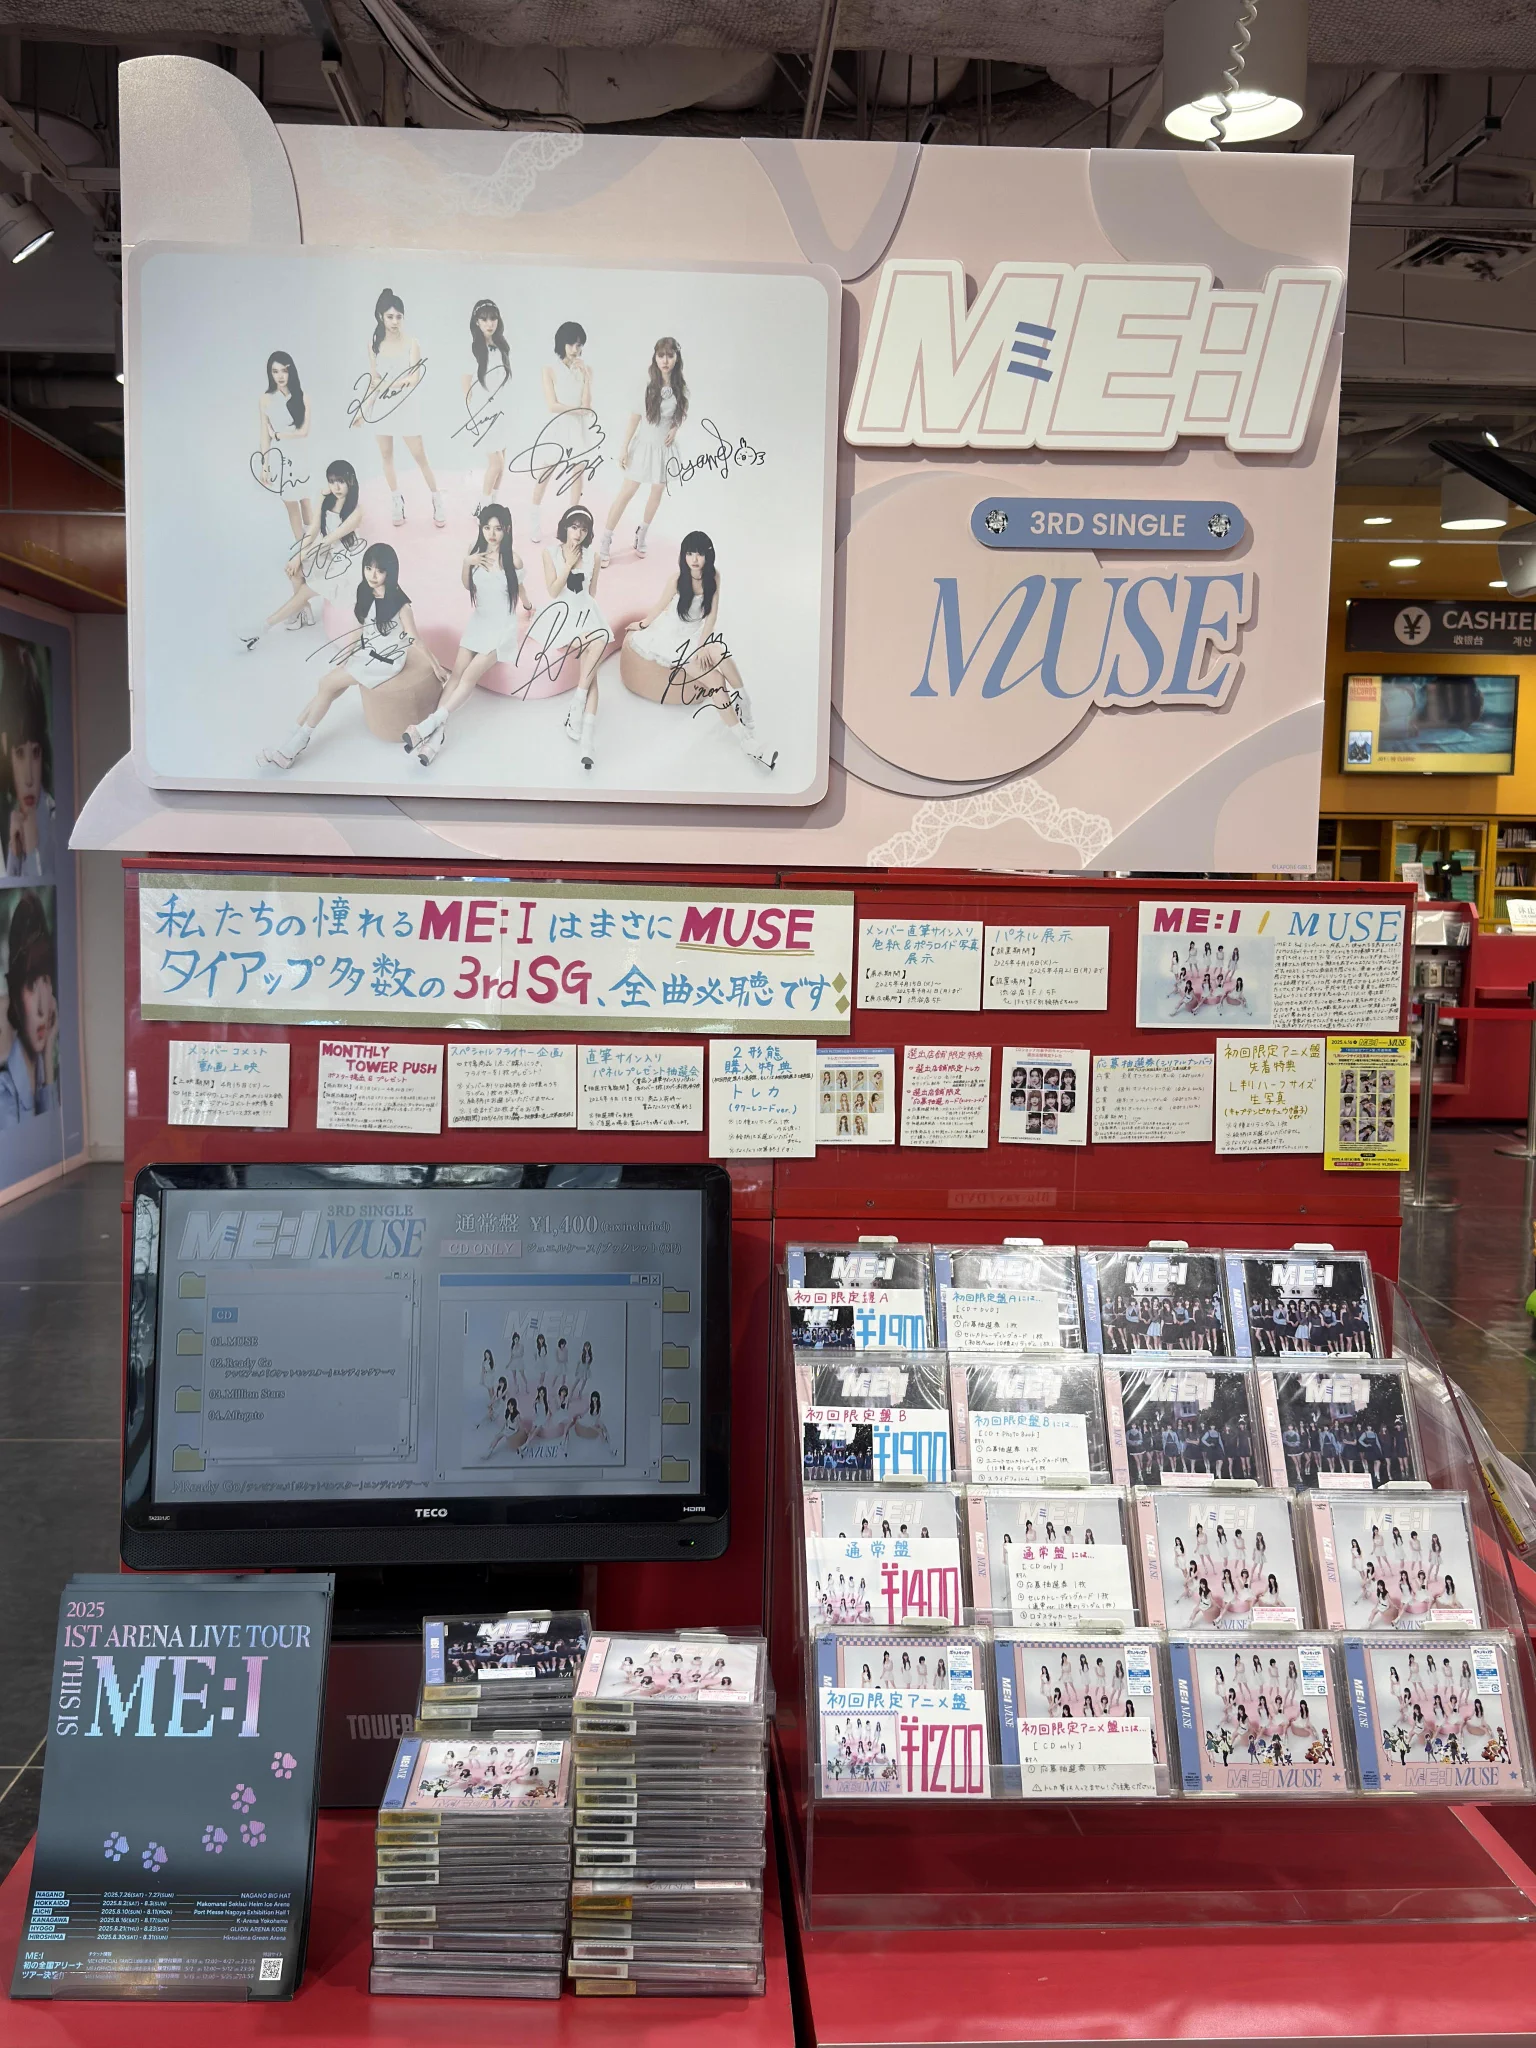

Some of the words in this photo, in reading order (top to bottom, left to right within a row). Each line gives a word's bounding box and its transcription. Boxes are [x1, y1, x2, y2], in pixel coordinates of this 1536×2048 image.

[856, 268, 1334, 440] ME:I
[1029, 511, 1086, 537] 3RD
[1091, 512, 1187, 539] SINGLE
[910, 571, 1246, 700] MUSE
[995, 928, 1074, 944] パネル展示
[1153, 907, 1242, 934] ME:I
[1287, 910, 1402, 943] MUSE
[904, 952, 935, 965] 展示
[321, 1042, 391, 1059] MONTHLY
[1224, 1043, 1322, 1061] 初回限定アニメ盤
[345, 1058, 399, 1074] TOWER
[402, 1061, 438, 1075] PUSH
[732, 1083, 781, 1101] トレカ
[327, 1204, 355, 1217] 3RD
[359, 1205, 414, 1217] SINGLE
[177, 1210, 322, 1260] ME:I
[455, 1212, 520, 1234] 通常盤
[529, 1214, 599, 1236] ¥1,400
[318, 1218, 427, 1259] MUSE
[448, 1242, 474, 1256] CD
[477, 1242, 515, 1256] ONLY
[831, 1255, 896, 1281] ME:I
[1124, 1261, 1188, 1285] ME:I
[1270, 1263, 1334, 1287] ME:I
[216, 1310, 232, 1320] CD
[414, 1508, 448, 1518] TECO
[852, 1499, 924, 1525] ME:I
[1017, 1500, 1088, 1526] ME:I
[1187, 1503, 1257, 1531] ME:I
[1364, 1506, 1432, 1532] ME:I
[844, 1540, 912, 1560] 通常盤
[66, 1601, 106, 1618] 2025
[64, 1624, 104, 1648] 1ST
[104, 1624, 185, 1648] ARENA
[188, 1625, 242, 1648] LIVE
[245, 1625, 312, 1649] TOUR
[58, 1655, 85, 1710] THIS
[84, 1655, 269, 1737] ME:I
[826, 1689, 971, 1711] 初回限定アニメ盤
[56, 1714, 79, 1736] IS
[346, 1713, 414, 1740] TOWER
[899, 1715, 984, 1794] ¥1200
[1226, 1768, 1275, 1788] ME:I
[1276, 1768, 1323, 1788] MUSE
[1405, 1767, 1452, 1787] ME:I
[1454, 1767, 1499, 1787] MUSE
[222, 1934, 251, 1942] Hiroshima
[24, 1951, 45, 1960] ME:I
